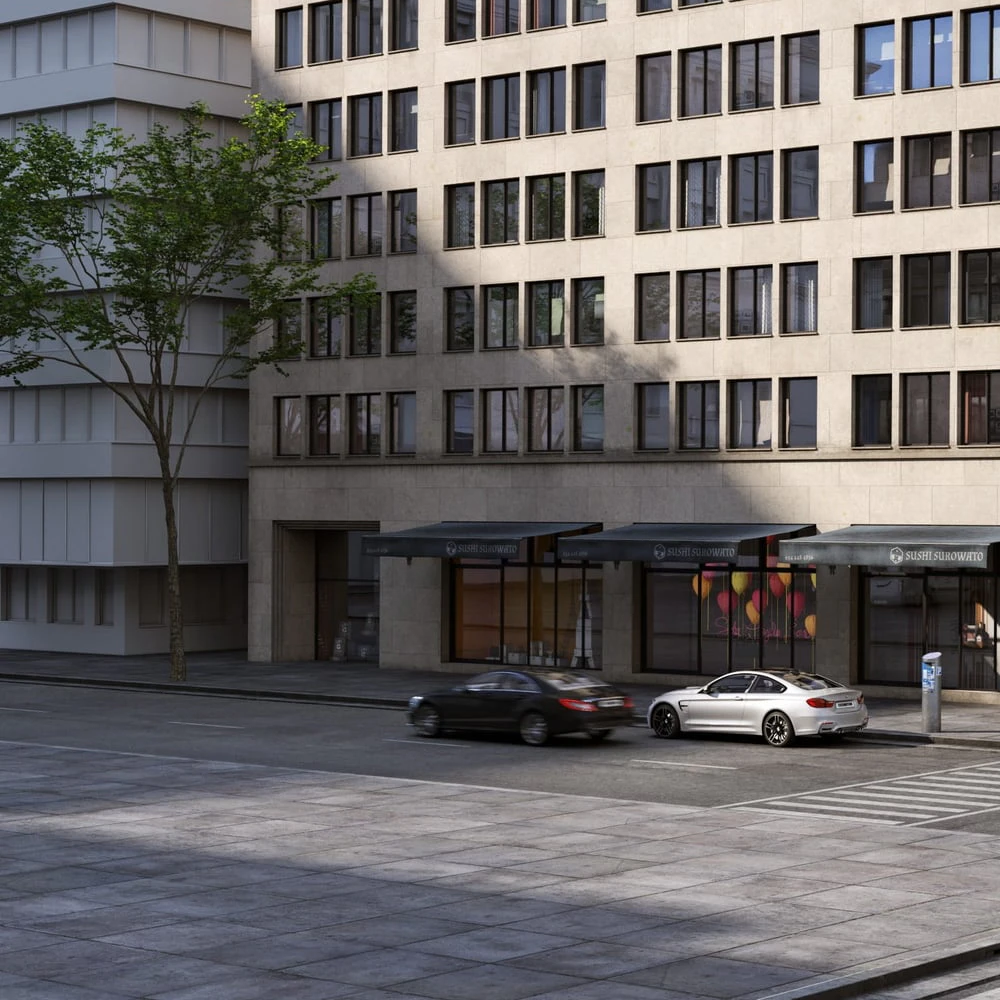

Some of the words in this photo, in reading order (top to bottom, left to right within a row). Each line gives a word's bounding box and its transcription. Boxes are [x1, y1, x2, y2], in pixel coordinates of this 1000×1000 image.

[457, 544, 479, 553] SUSHI
[666, 547, 690, 557] SUSHI
[905, 551, 932, 561] SUSHI
[933, 551, 984, 562] SUROWATO
